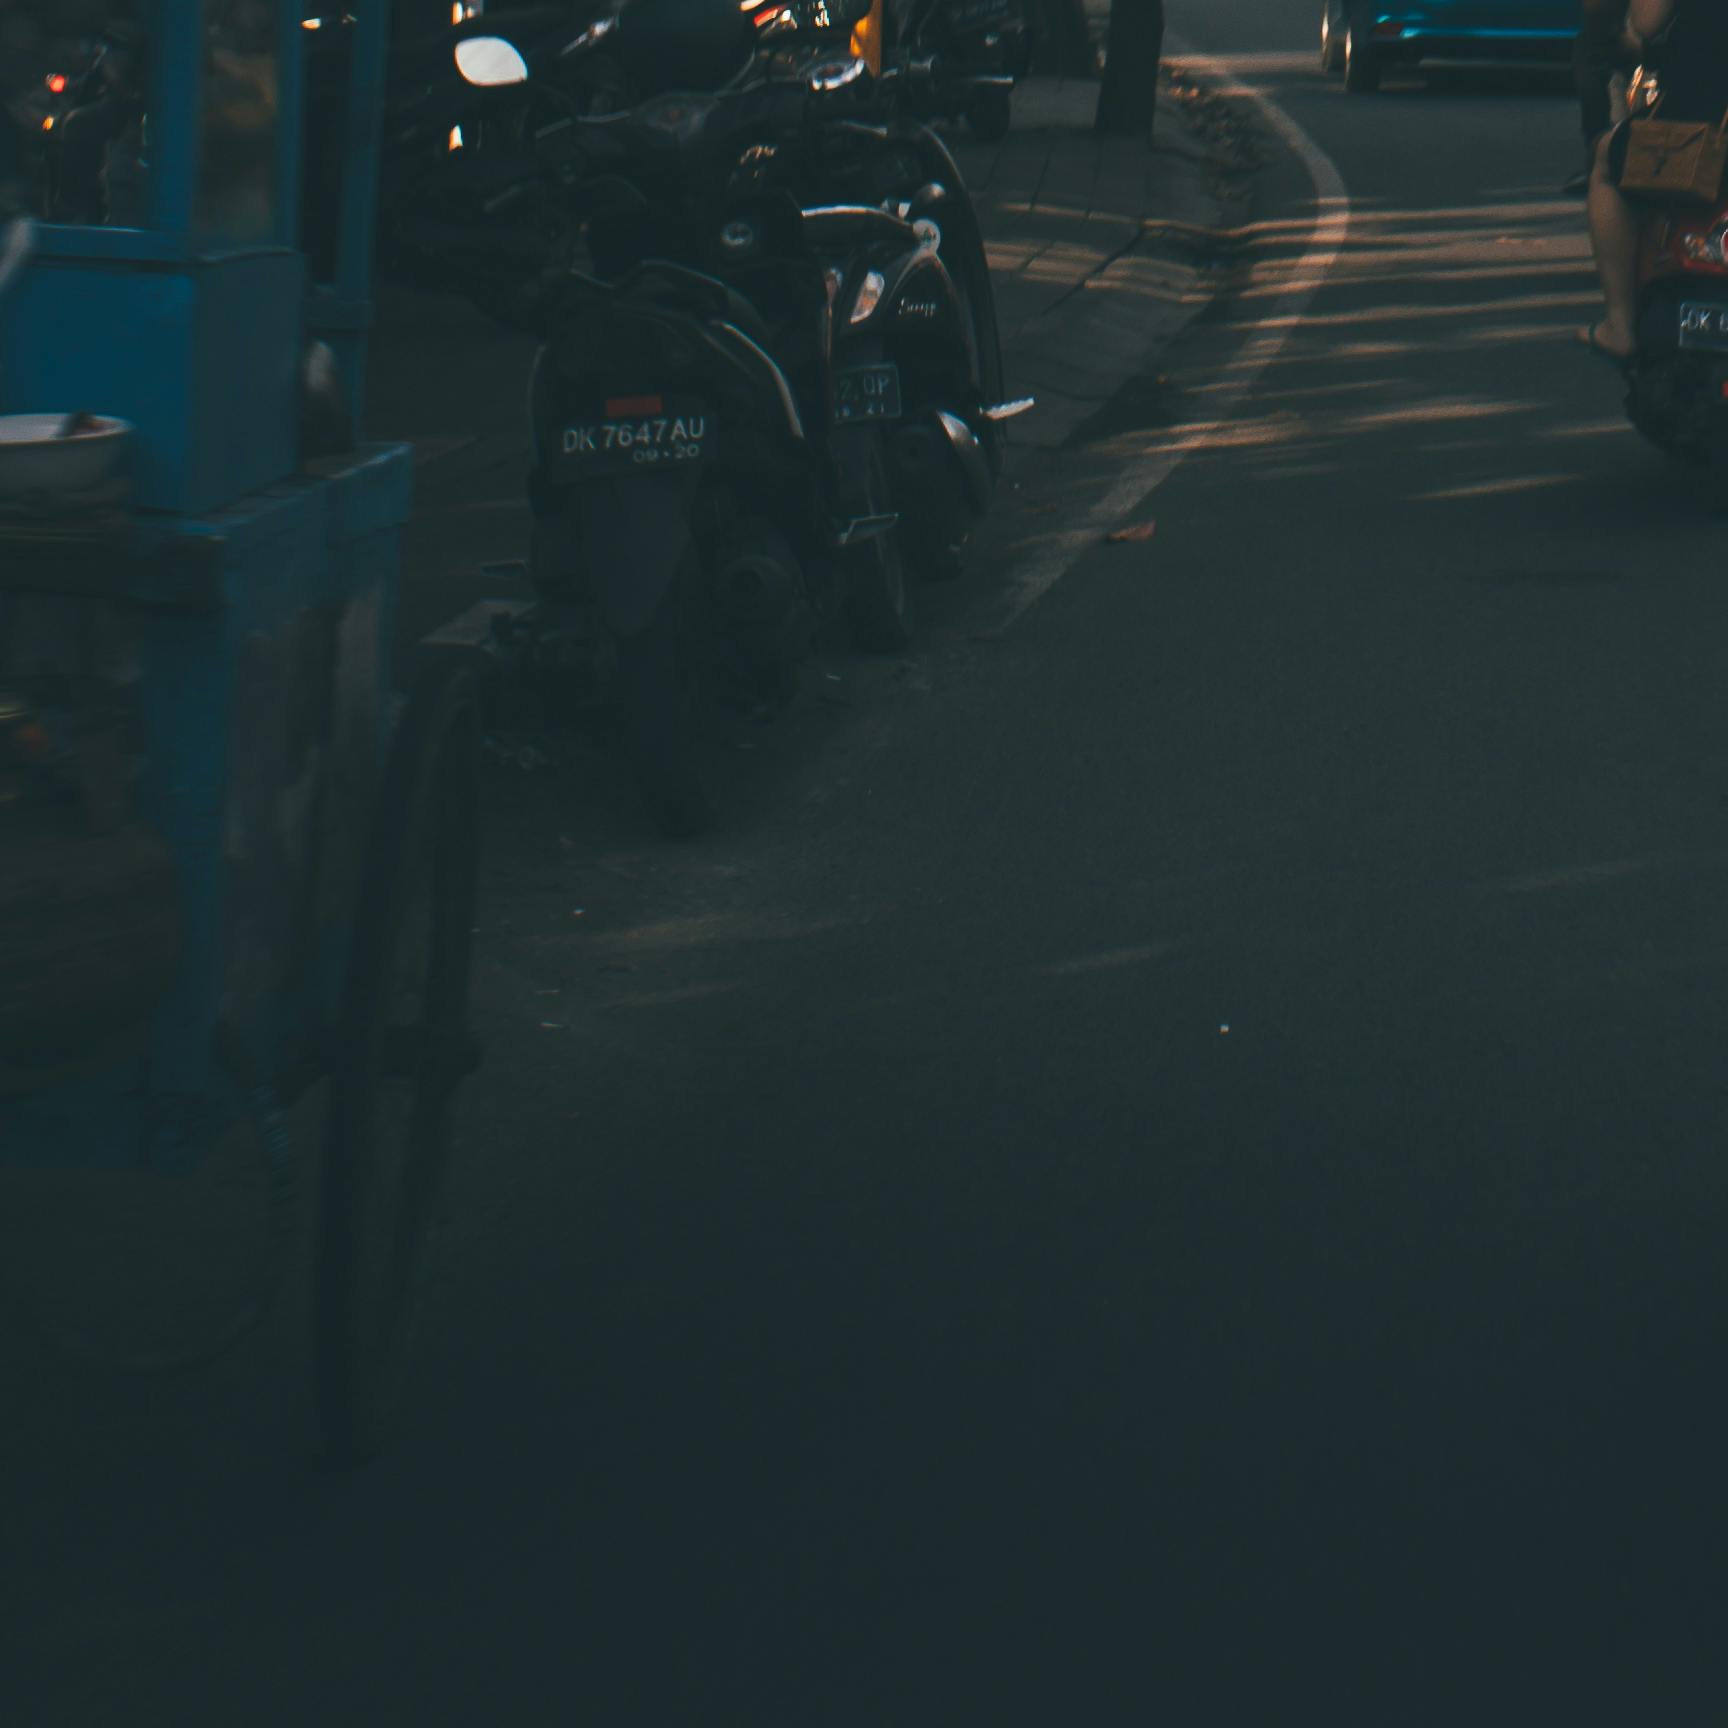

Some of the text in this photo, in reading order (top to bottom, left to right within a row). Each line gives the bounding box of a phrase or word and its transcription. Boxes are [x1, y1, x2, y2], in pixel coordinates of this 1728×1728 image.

[562, 417, 705, 454] DK 7647 AU
